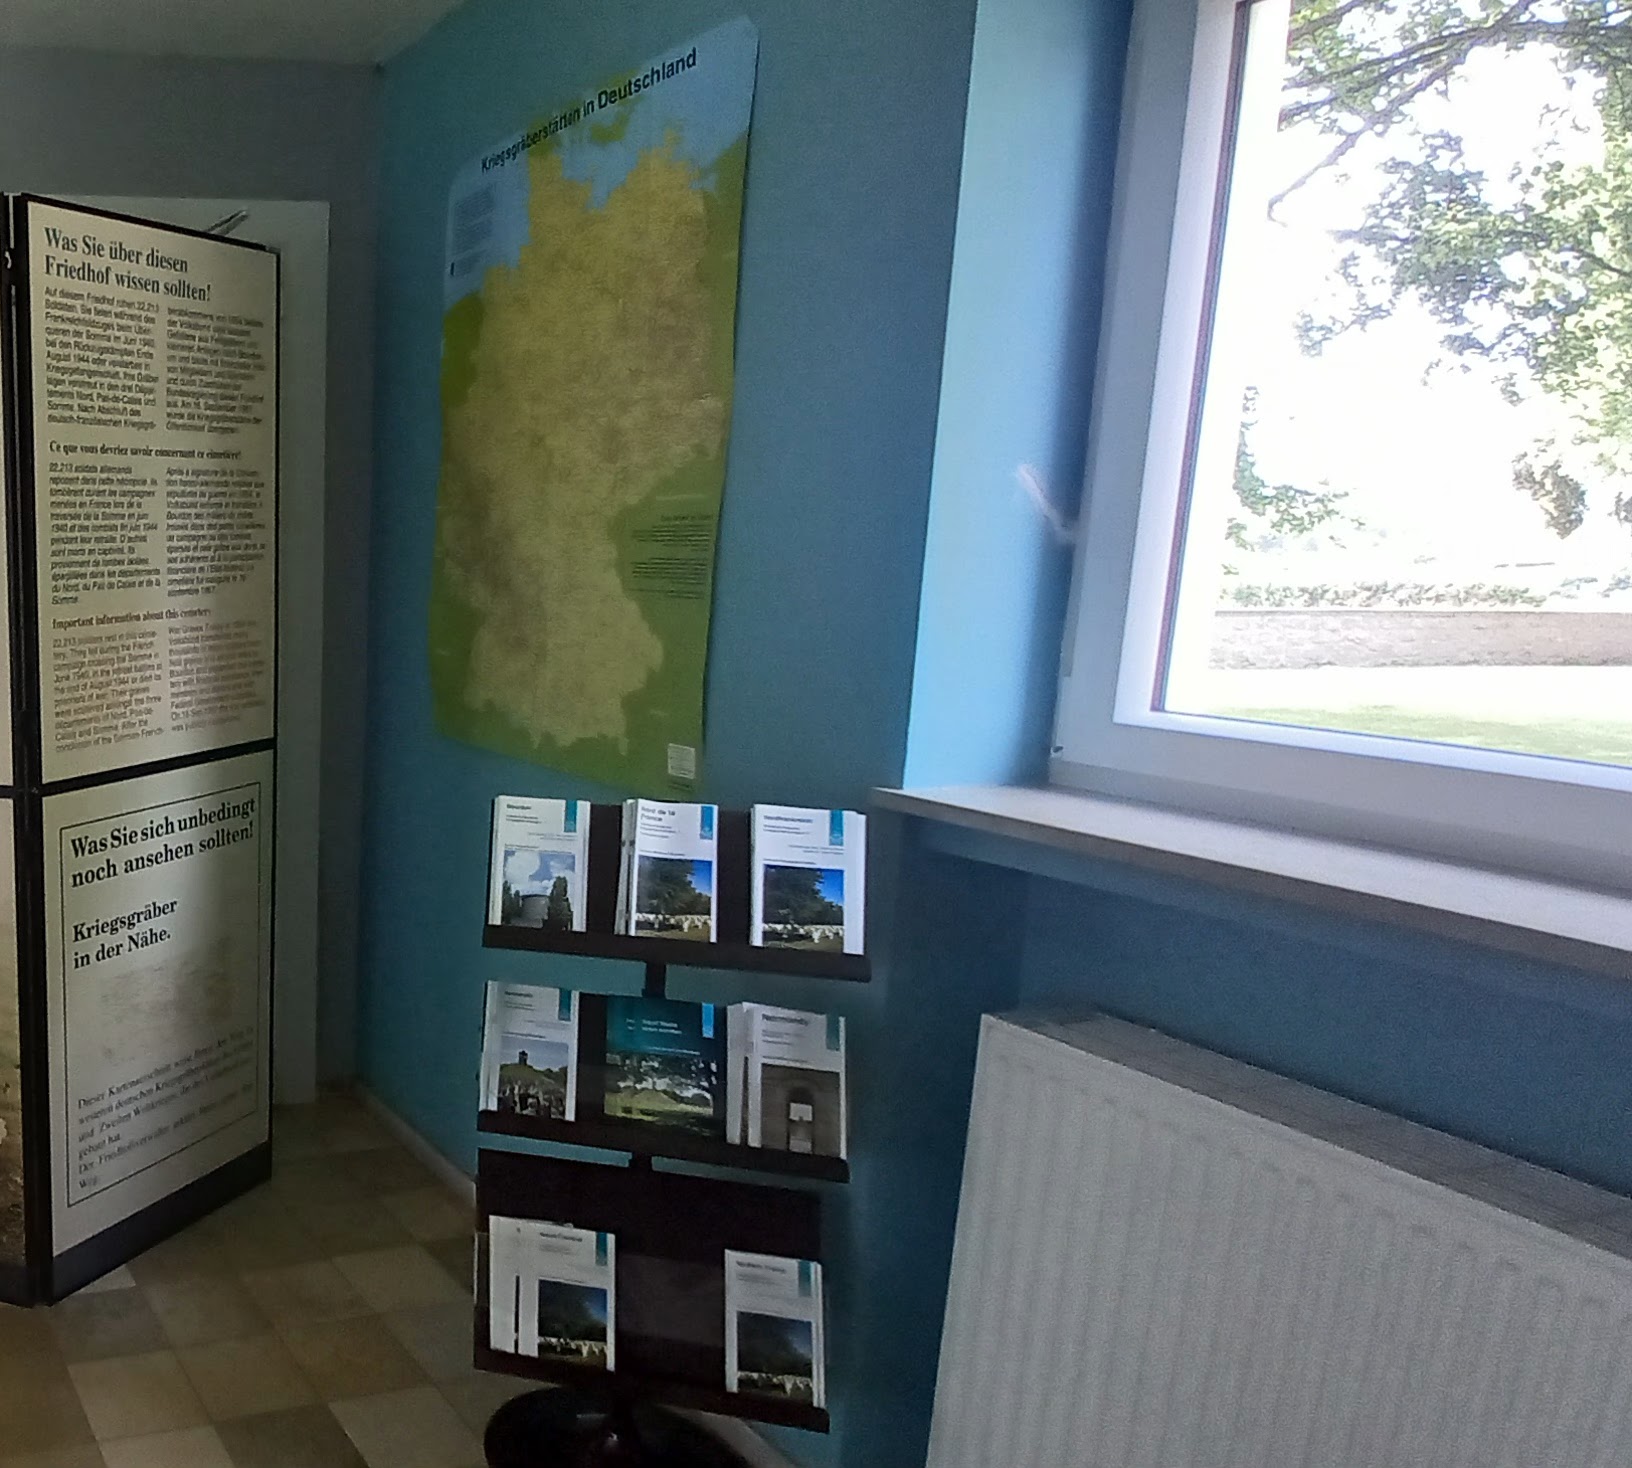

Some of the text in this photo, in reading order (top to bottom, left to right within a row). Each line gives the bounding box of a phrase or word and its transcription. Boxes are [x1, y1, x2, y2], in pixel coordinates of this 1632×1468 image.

[583, 99, 595, 117] in
[597, 46, 697, 110] Deutschland
[44, 227, 188, 273] Was Sie über diesen
[45, 254, 211, 302] Friedhof wissen sollten!
[71, 798, 256, 859] Was Sie sich unbedingt
[71, 820, 254, 888] noch ansehen sollten!
[72, 900, 178, 943] Kriegsgräber
[74, 927, 171, 970] in der Nähe.
